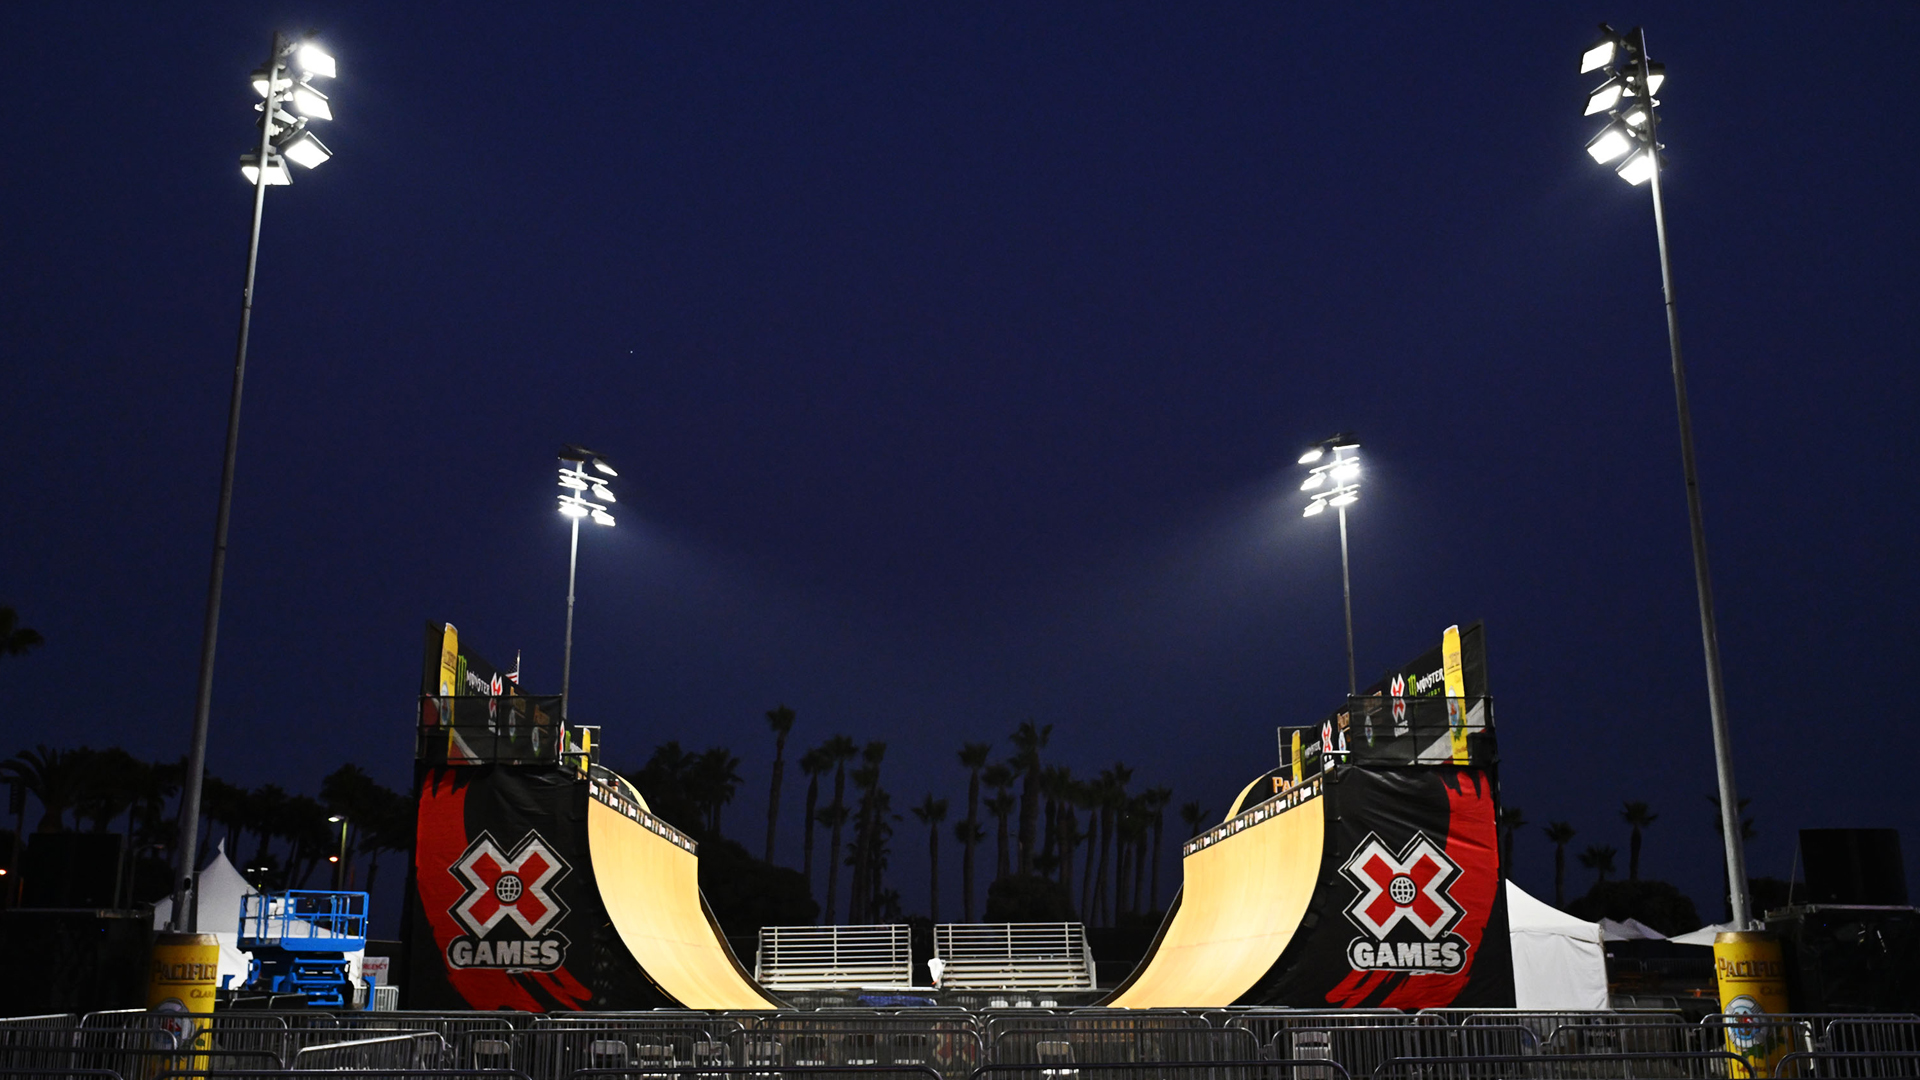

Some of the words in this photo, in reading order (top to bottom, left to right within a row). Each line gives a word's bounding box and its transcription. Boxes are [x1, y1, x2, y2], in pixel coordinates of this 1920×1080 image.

[448, 829, 573, 940] X
[1338, 831, 1467, 942] X
[452, 940, 560, 966] GAMES
[1353, 941, 1461, 968] GAMES
